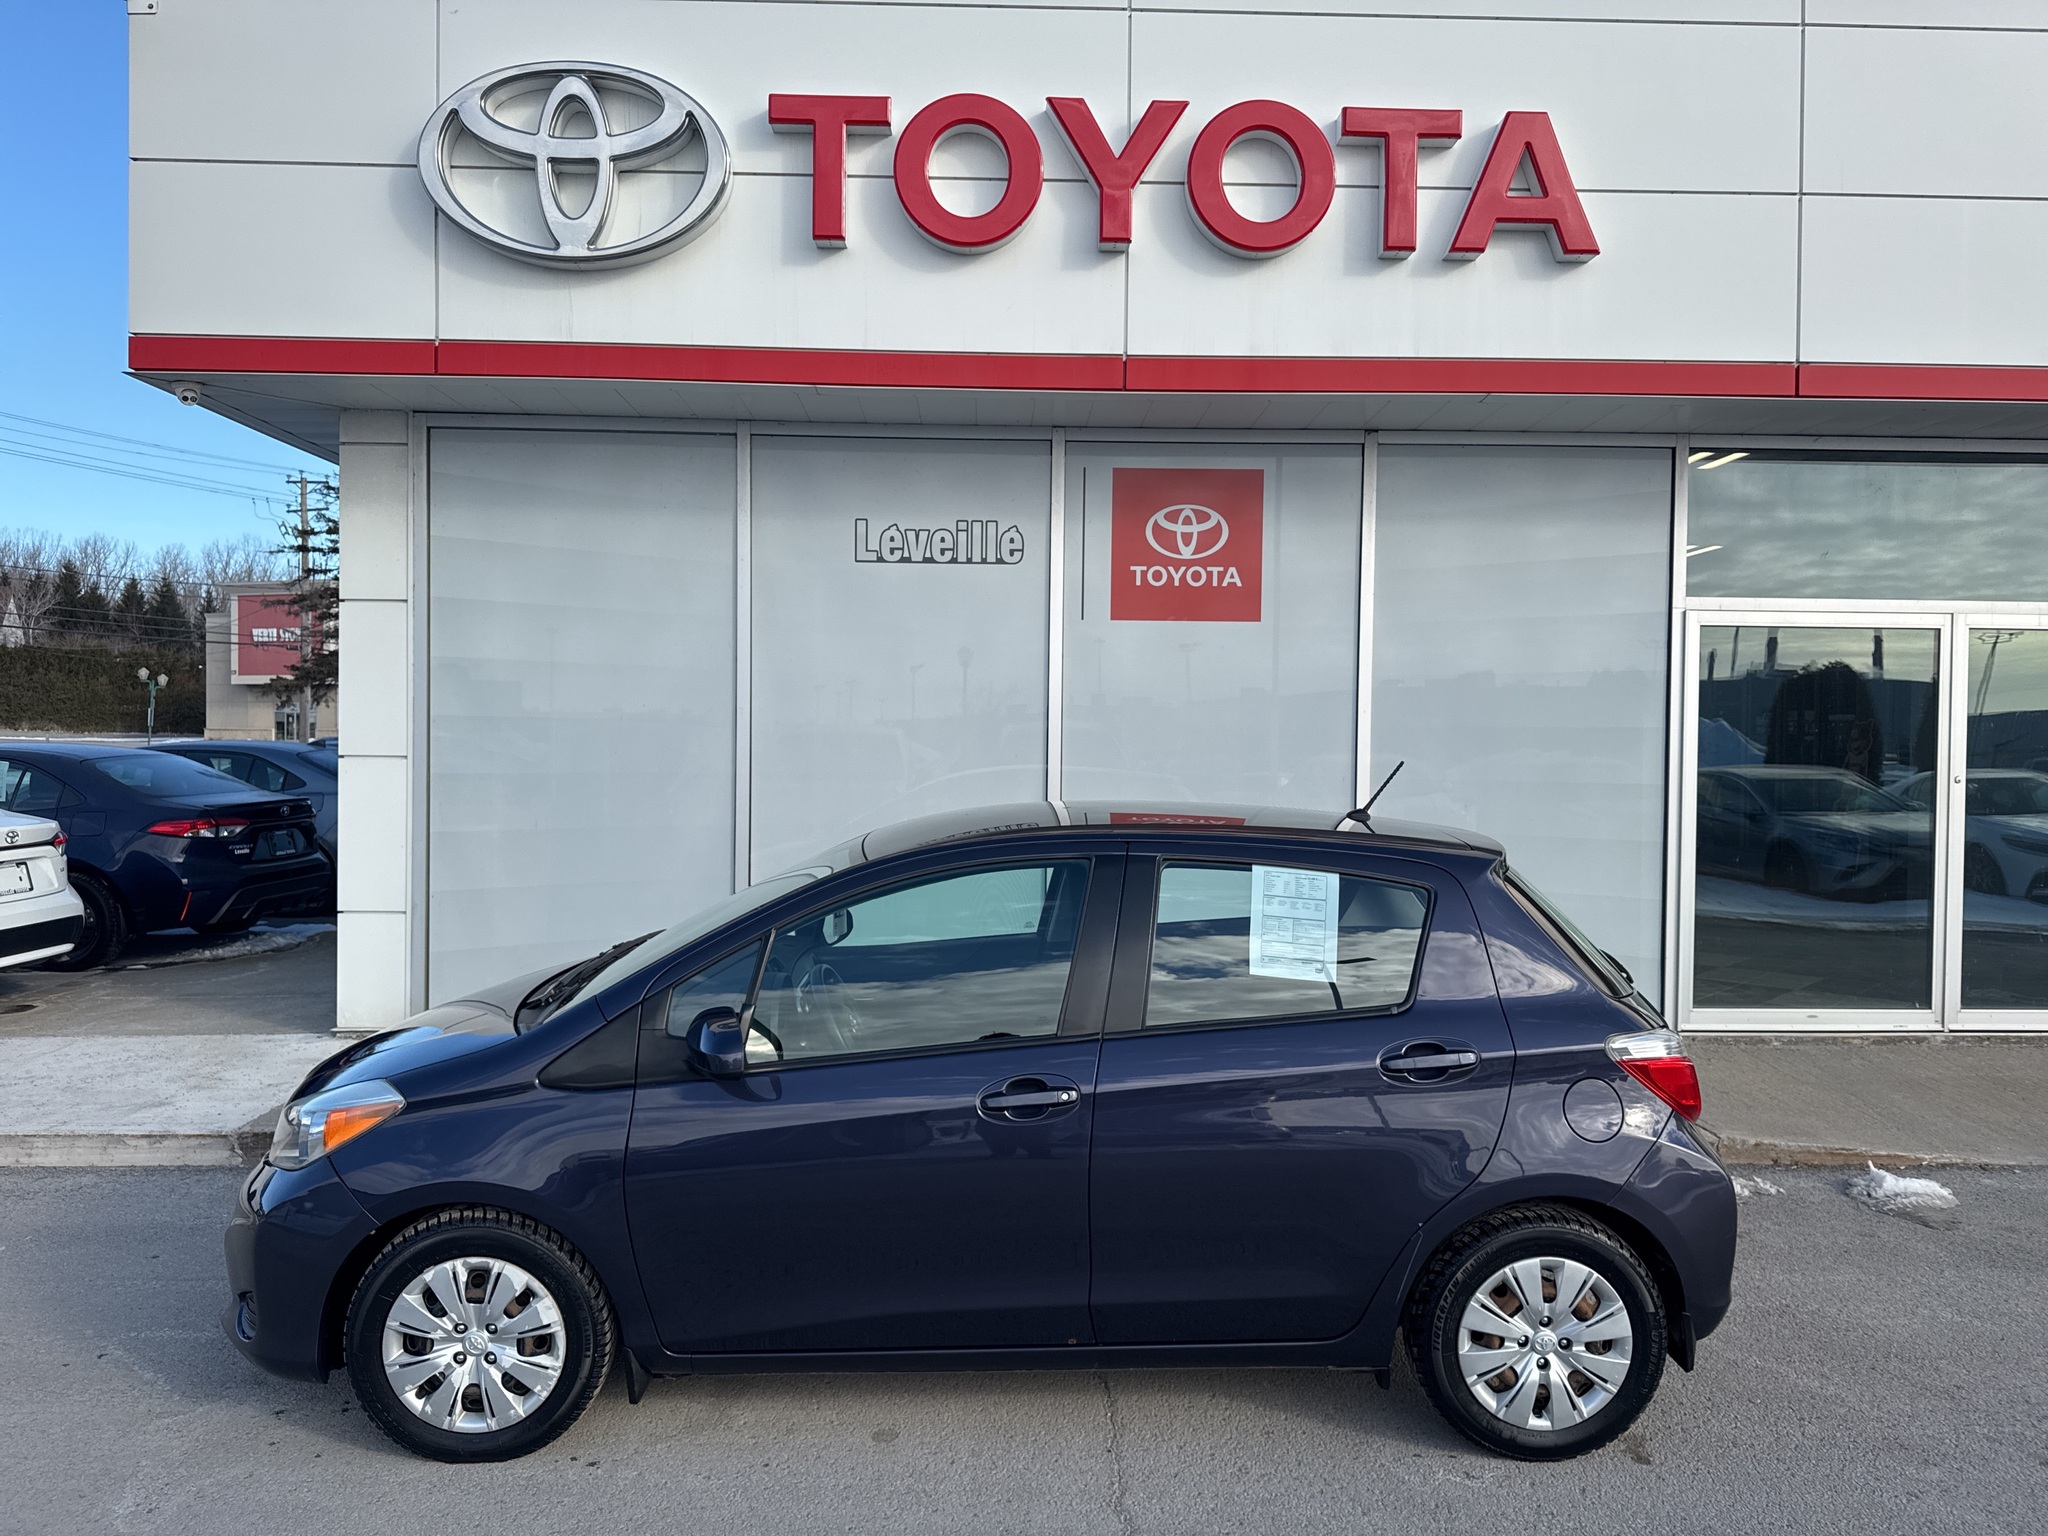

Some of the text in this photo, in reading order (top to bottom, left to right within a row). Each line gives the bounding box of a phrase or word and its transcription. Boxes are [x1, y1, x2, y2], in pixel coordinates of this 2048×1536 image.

[768, 93, 1600, 259] TOYOTA
[854, 517, 1025, 565] Léveillé
[1129, 565, 1243, 588] TOYOTA
